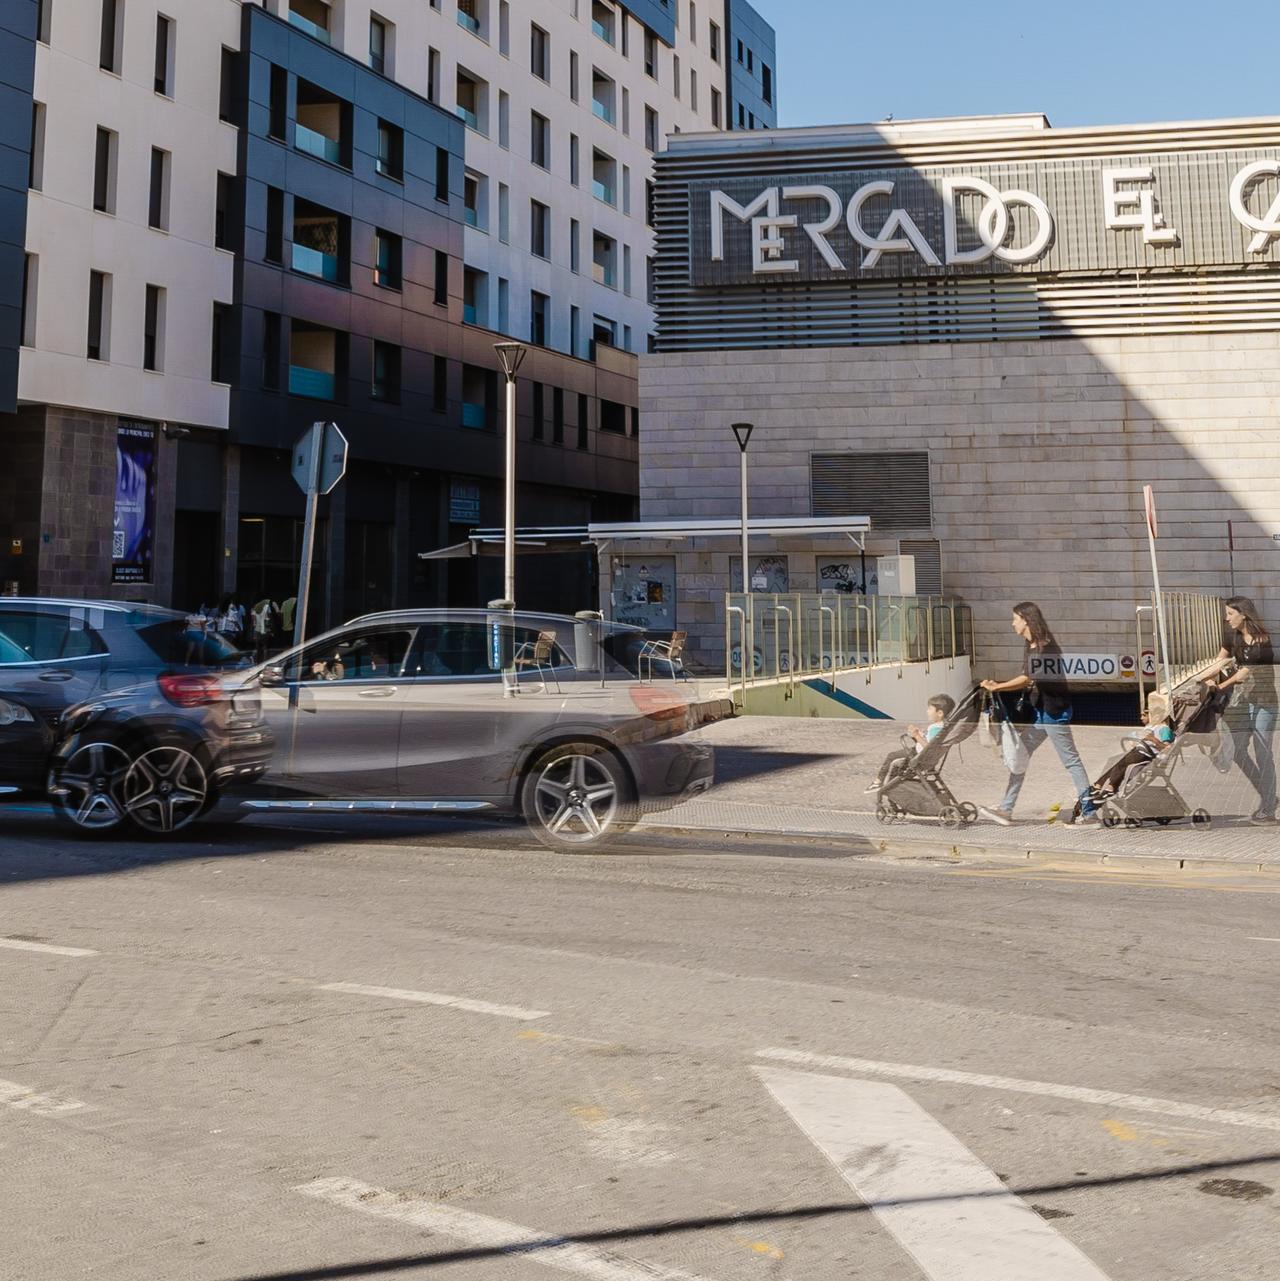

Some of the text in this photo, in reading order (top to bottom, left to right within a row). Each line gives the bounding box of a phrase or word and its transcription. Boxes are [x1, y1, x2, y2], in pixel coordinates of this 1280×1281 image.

[710, 176, 1053, 274] MERCADO
[1102, 167, 1177, 244] EL
[1030, 658, 1115, 675] PRIVADO
